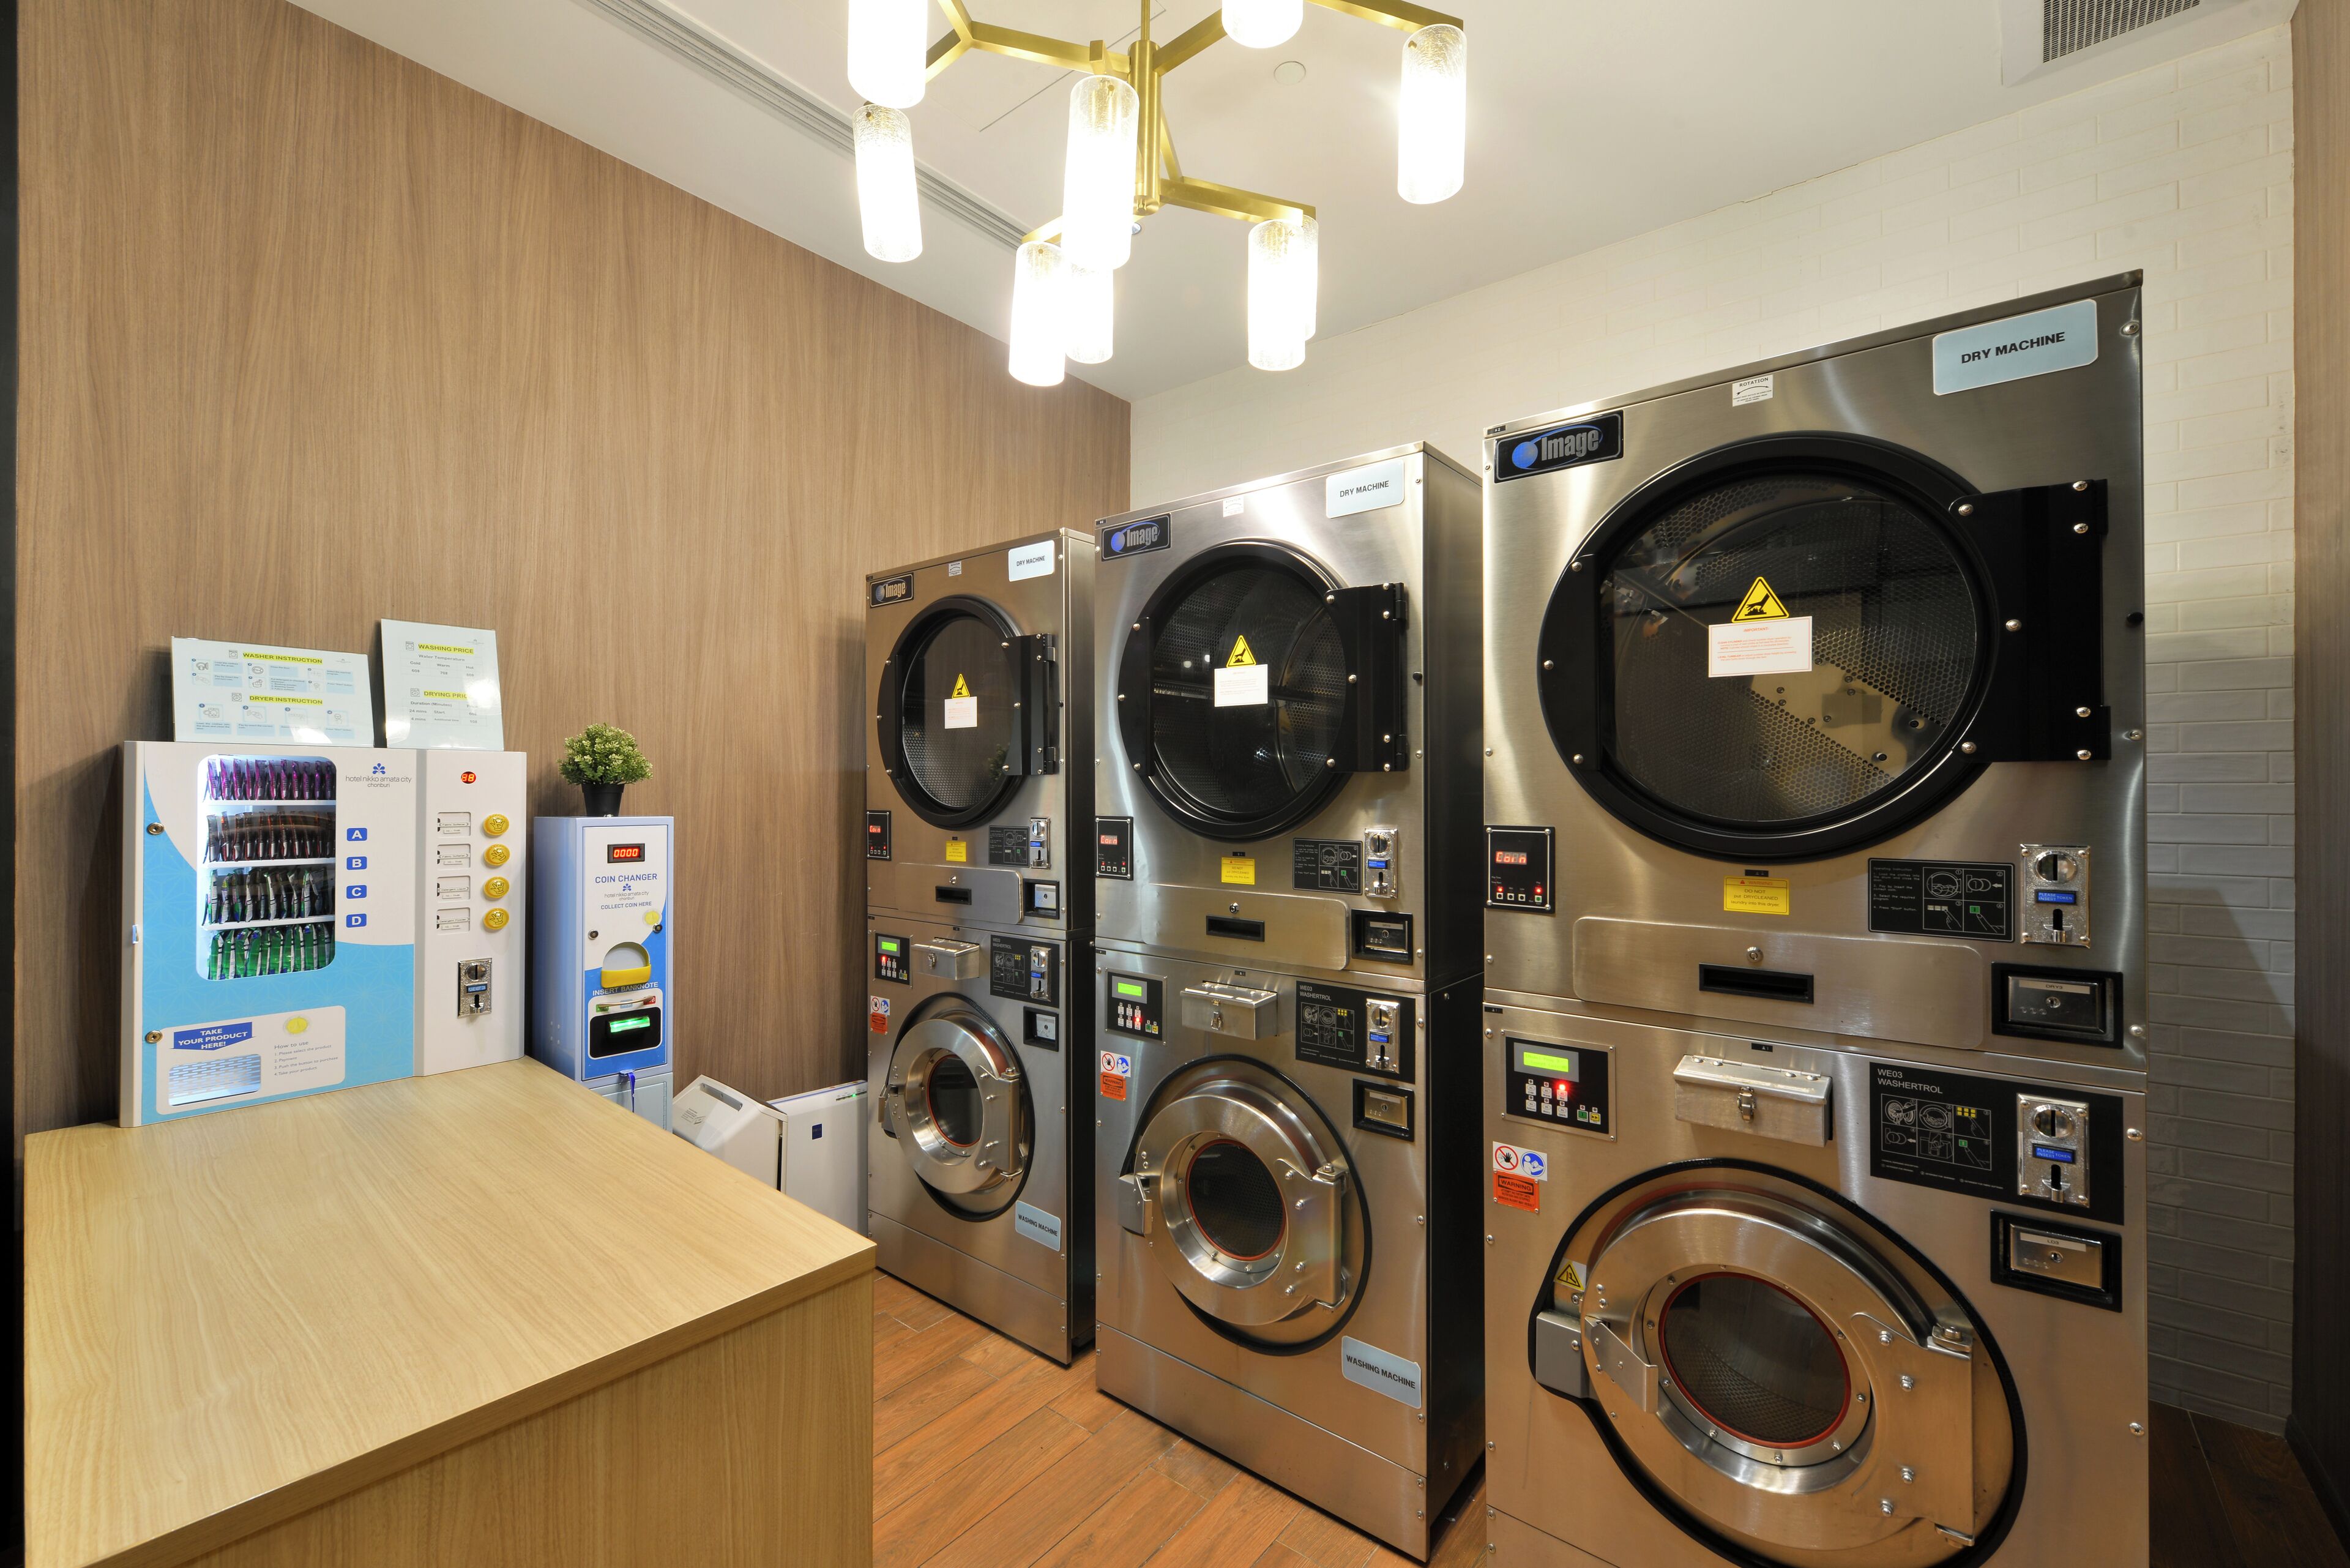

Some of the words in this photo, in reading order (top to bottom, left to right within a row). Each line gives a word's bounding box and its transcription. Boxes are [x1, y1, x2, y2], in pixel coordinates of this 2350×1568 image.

[1961, 348, 1991, 364] DRY
[1996, 332, 2065, 356] MACHINE
[1739, 377, 1769, 387] ROTATION
[1542, 430, 1598, 461] Image
[1340, 488, 1354, 498] DRY
[1356, 480, 1389, 494] MACHINE
[1127, 526, 1158, 547] Image
[1026, 556, 1045, 564] MACHINE
[886, 583, 906, 598] Image
[351, 829, 363, 840] A
[614, 848, 638, 857] 0000
[351, 858, 362, 868] B
[618, 873, 657, 882] CHANGER
[351, 887, 362, 897] C
[351, 916, 362, 925] D
[592, 987, 620, 996] INSERT
[621, 982, 658, 992] BANKNOTE
[1300, 991, 1332, 1001] WASHERTROL
[178, 1037, 204, 1046] YOUR
[205, 1031, 248, 1042] PRODUCT
[201, 1041, 226, 1050] HERE!
[1878, 1068, 1903, 1078] WE03
[1878, 1078, 1943, 1094] WASHERTROL
[1501, 1179, 1531, 1192] WARNING
[1018, 1214, 1038, 1227] WASHING
[1038, 1223, 1058, 1237] MACHINE
[1346, 1354, 1380, 1375] WASHING
[1381, 1368, 1416, 1389] MACHINE
